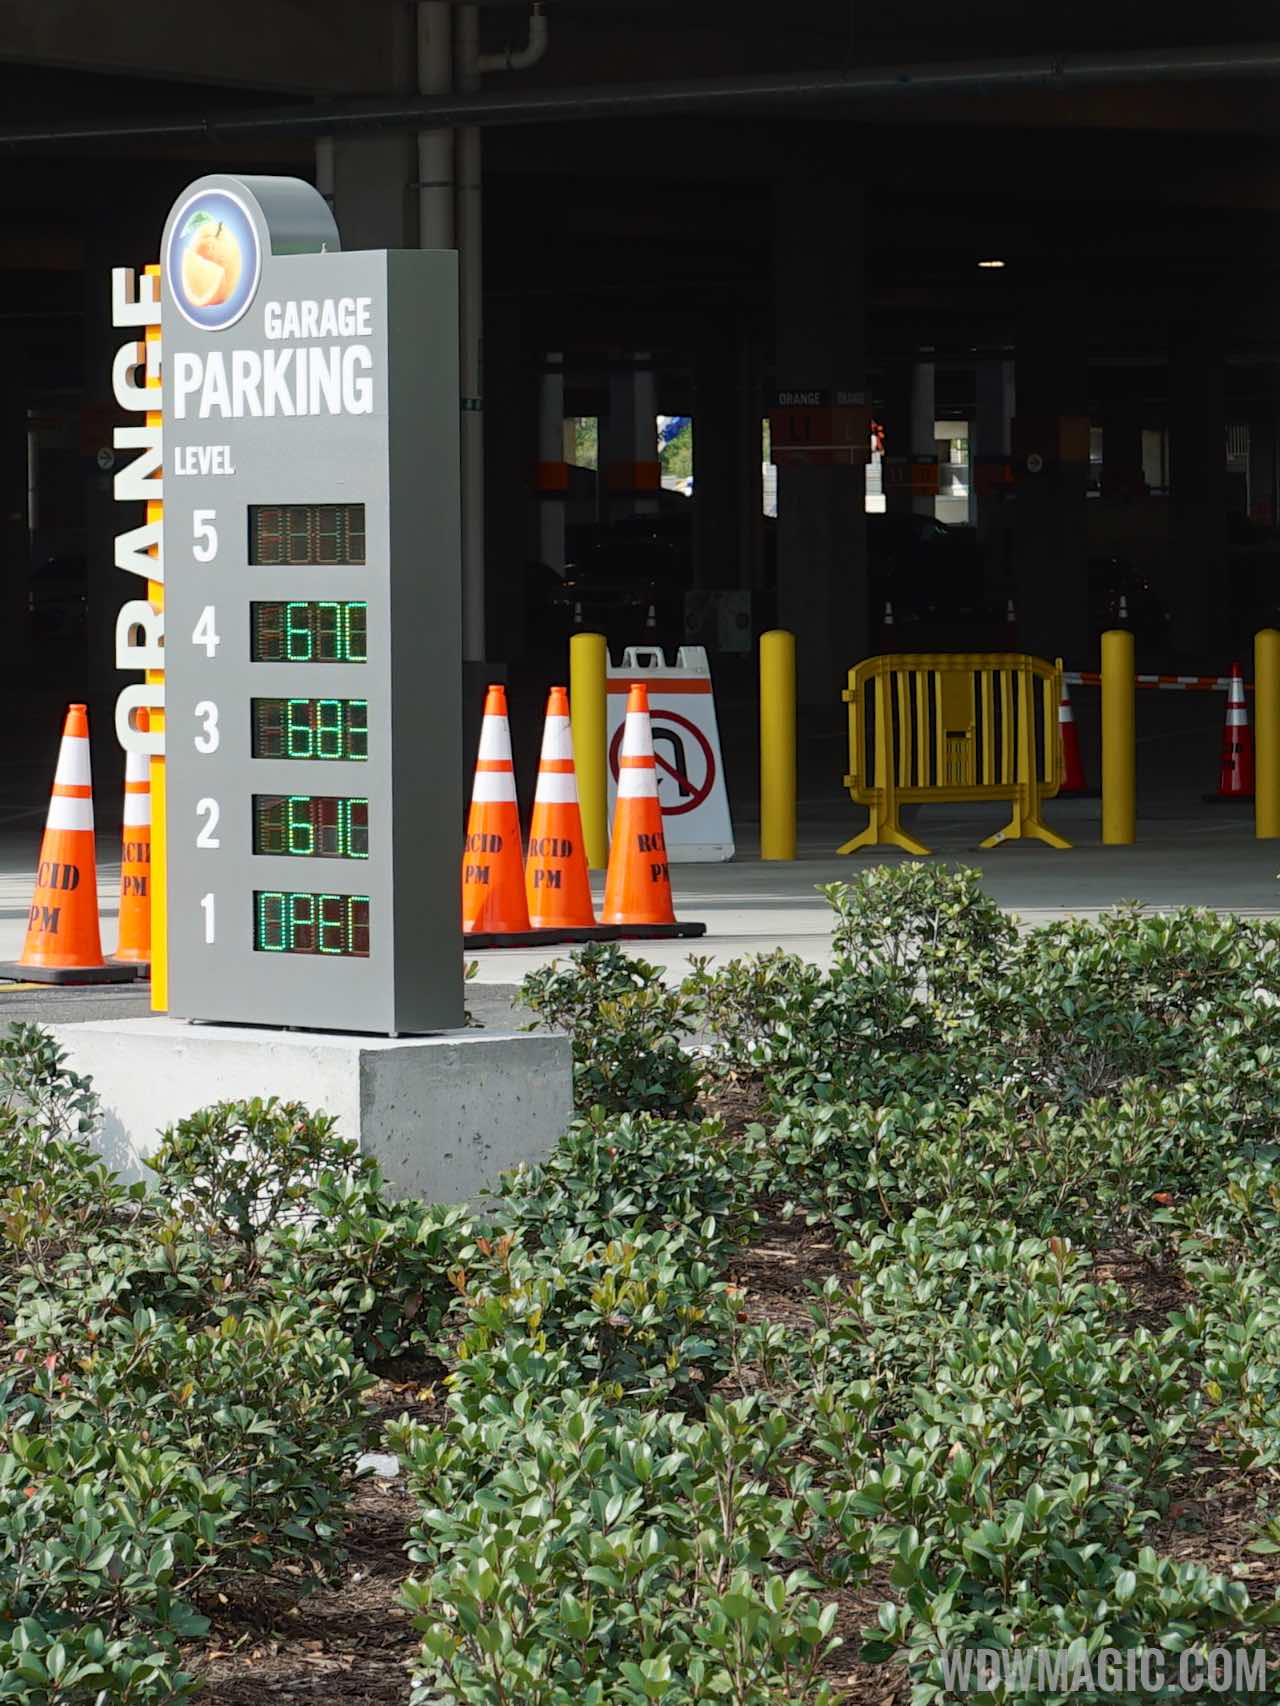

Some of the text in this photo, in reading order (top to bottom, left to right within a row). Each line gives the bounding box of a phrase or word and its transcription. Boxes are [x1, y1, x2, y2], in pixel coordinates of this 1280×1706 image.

[263, 297, 372, 340] GARAGE
[173, 344, 373, 420] PARKING
[778, 391, 822, 406] ORANGE
[174, 446, 236, 476] LEVEL
[112, 265, 165, 755] ORANGE
[192, 509, 219, 563] 5
[192, 605, 220, 658] 4
[194, 700, 220, 754] 3
[195, 797, 220, 848] 2
[529, 837, 573, 858] RCID
[38, 862, 80, 891] CID
[123, 876, 147, 896] PM
[465, 865, 490, 884] PM
[533, 869, 562, 889] PM
[28, 905, 62, 934] PM
[200, 892, 216, 944] 1
